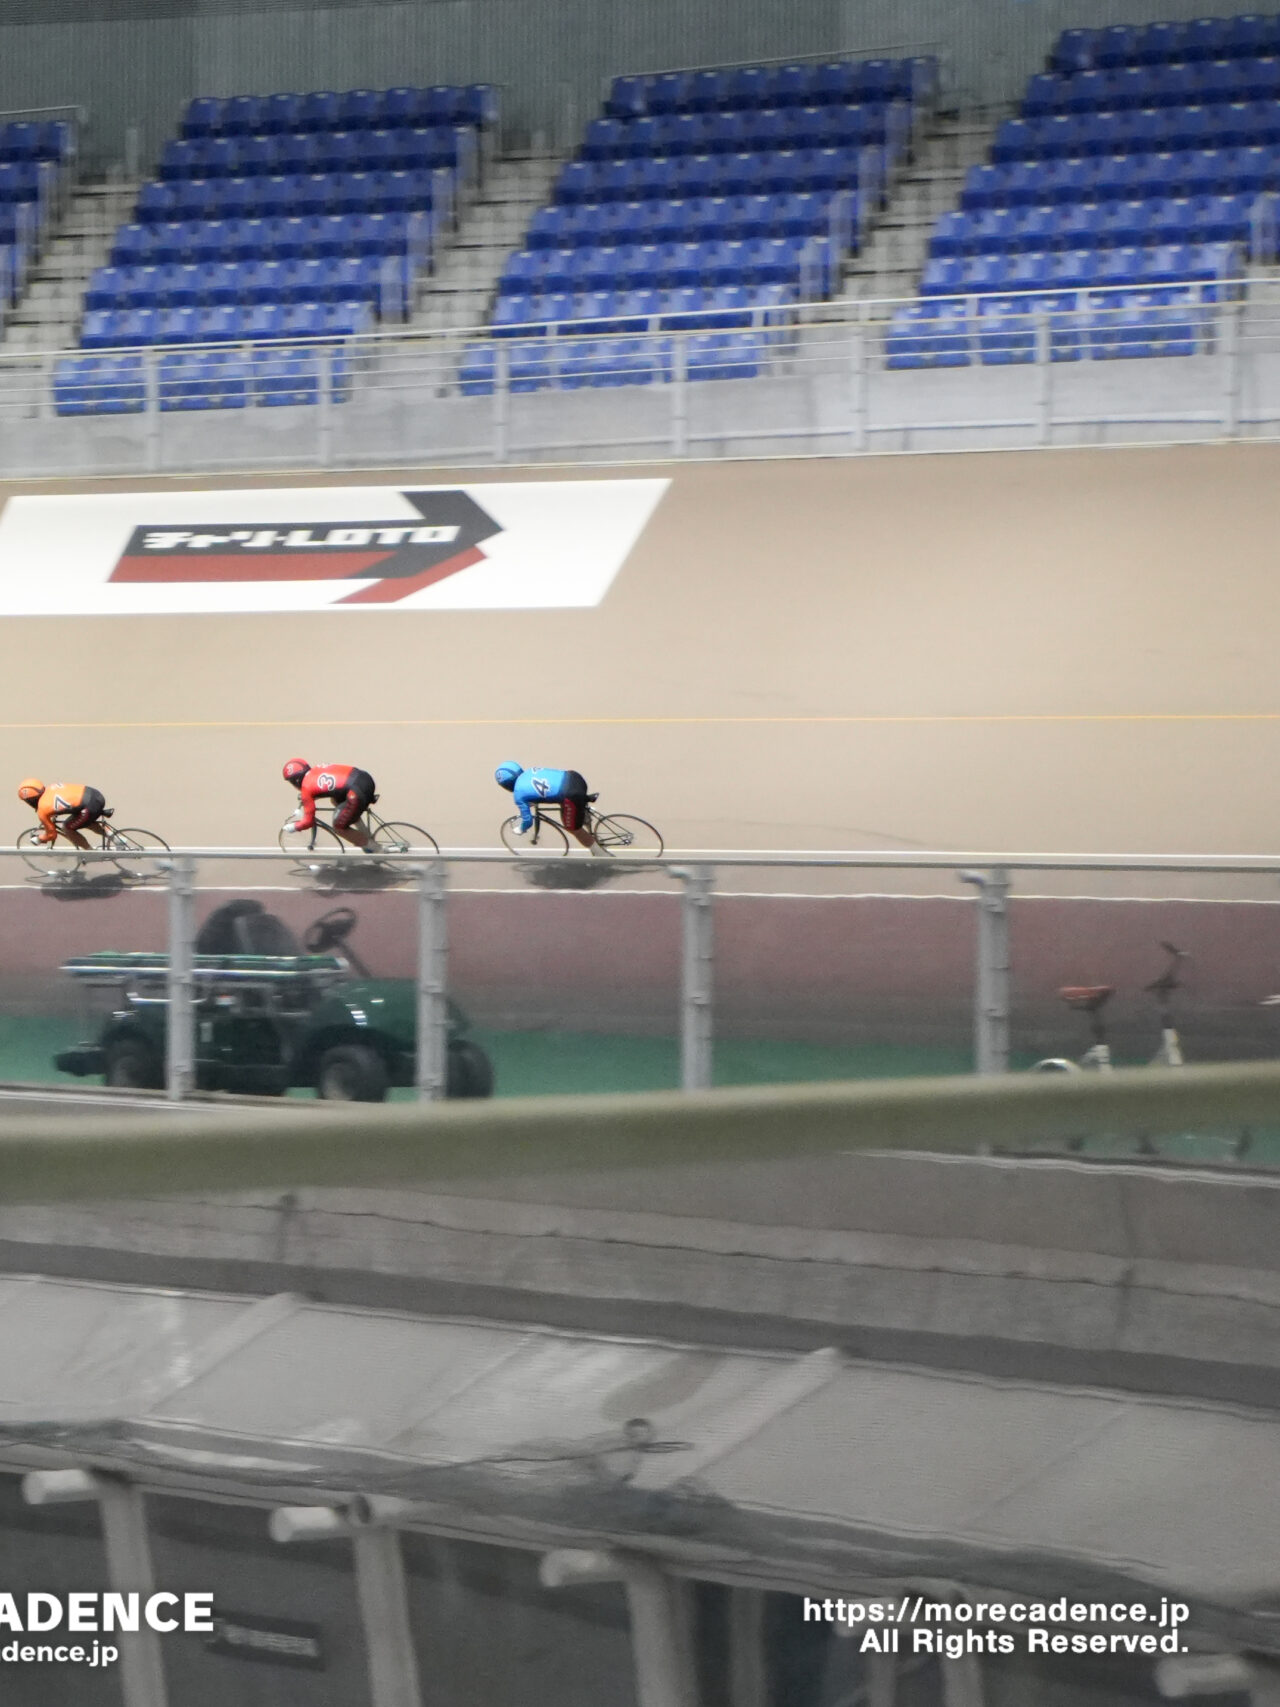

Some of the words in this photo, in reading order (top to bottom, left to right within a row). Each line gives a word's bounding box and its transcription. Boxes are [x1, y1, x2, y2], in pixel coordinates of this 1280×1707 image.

[318, 773, 335, 791] 3
[532, 778, 550, 798] 4
[54, 795, 72, 811] 7
